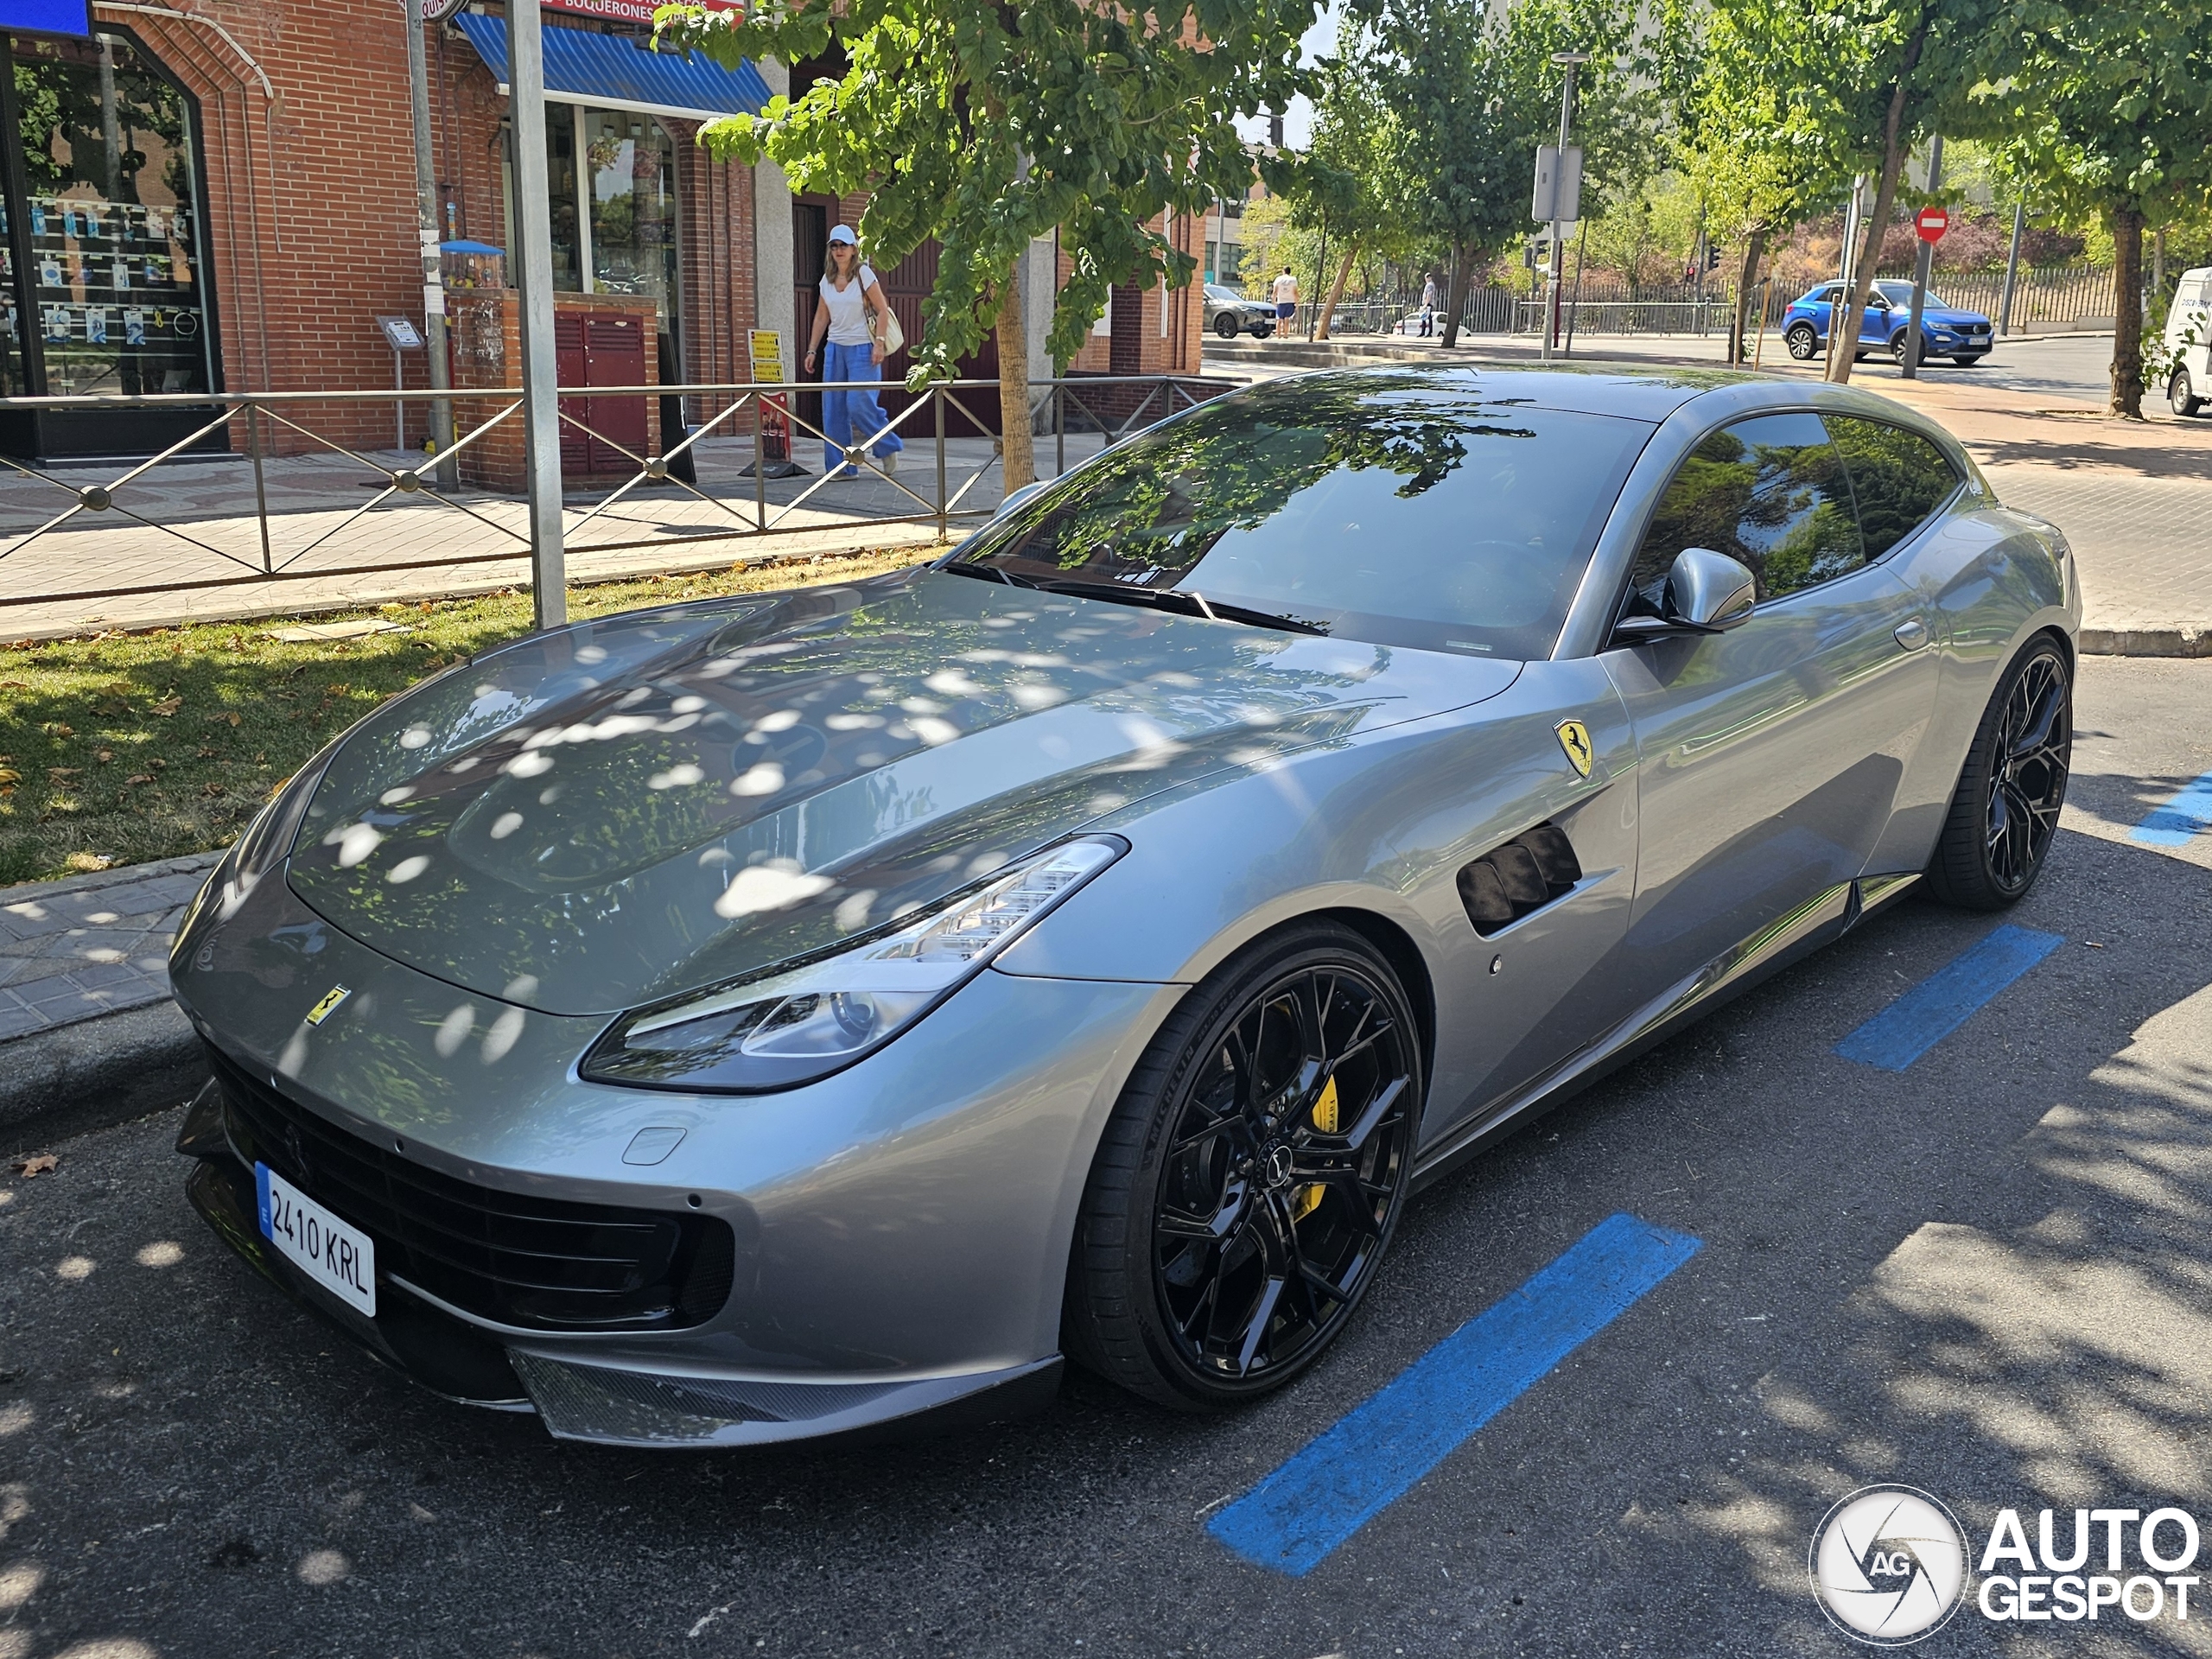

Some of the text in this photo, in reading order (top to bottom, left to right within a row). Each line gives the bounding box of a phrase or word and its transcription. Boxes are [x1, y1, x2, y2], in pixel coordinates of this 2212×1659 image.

[1150, 1045, 1194, 1143] MICHELIN
[272, 1190, 368, 1295] 2410 KRL
